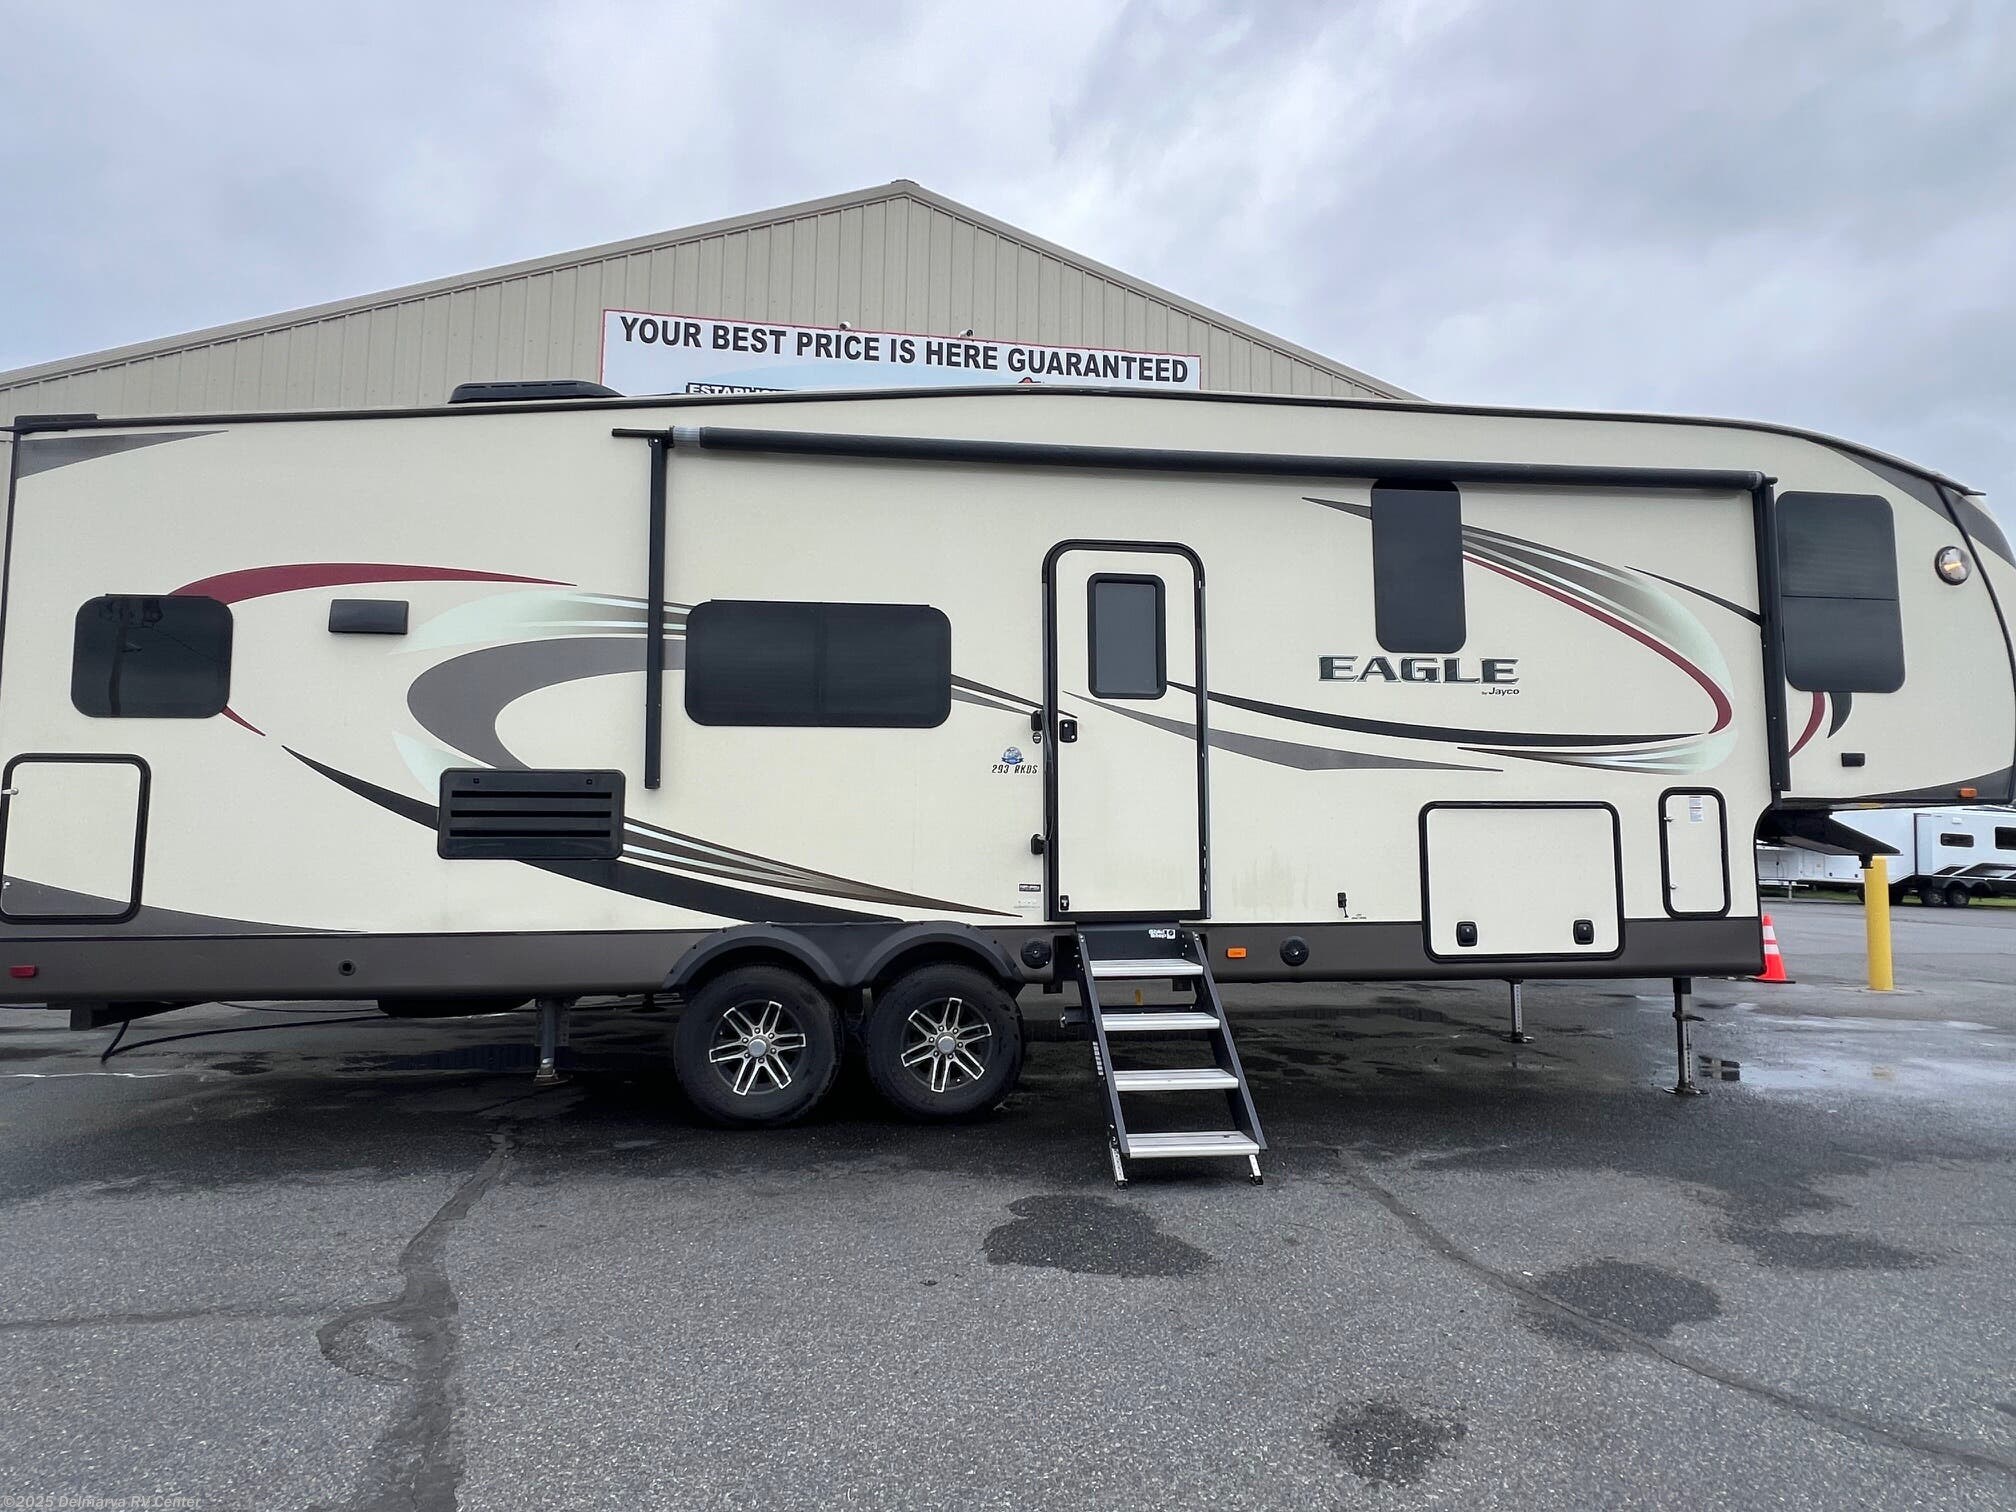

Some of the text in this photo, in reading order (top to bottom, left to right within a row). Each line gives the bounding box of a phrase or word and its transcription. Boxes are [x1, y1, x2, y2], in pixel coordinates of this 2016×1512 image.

[620, 316, 1188, 383] YOUR BEST PRICE IS HERE GUARANTEED
[1318, 655, 1520, 684] EAGLE
[1489, 687, 1520, 697] Jayco
[992, 764, 1038, 774] 293 RKDS
